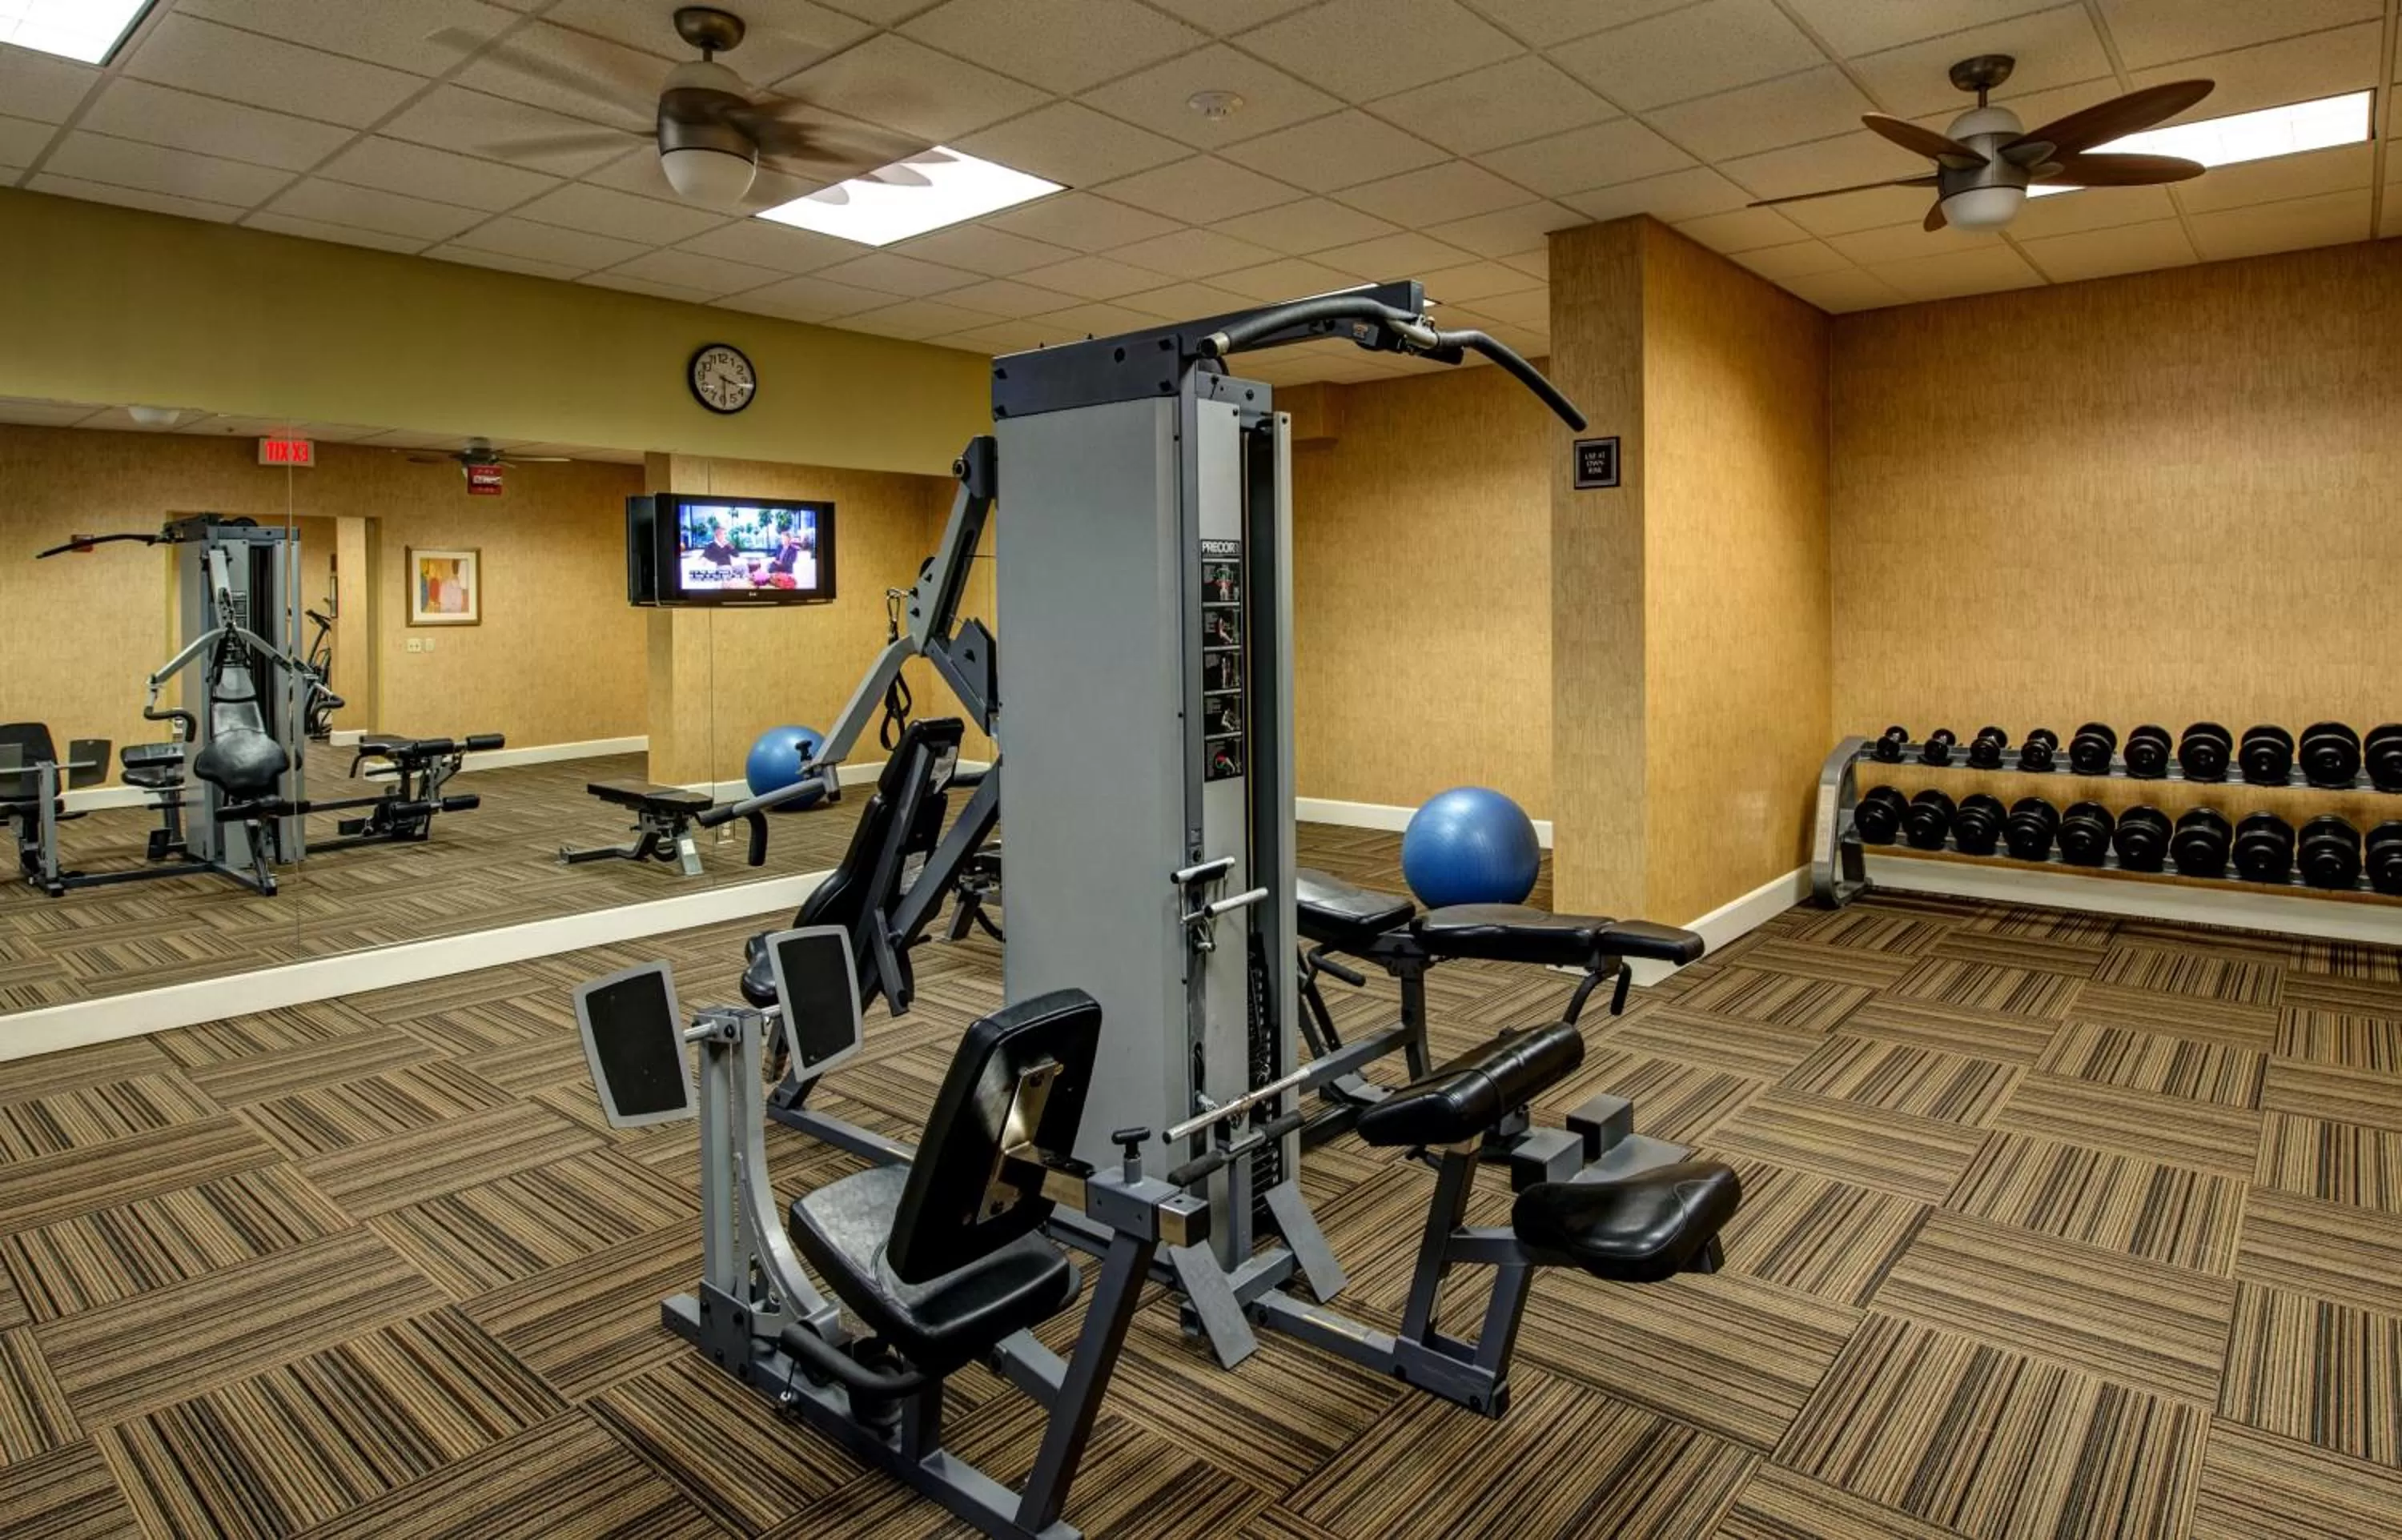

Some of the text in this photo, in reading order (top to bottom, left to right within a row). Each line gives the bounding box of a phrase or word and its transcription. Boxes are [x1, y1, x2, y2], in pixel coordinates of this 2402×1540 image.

[709, 355, 717, 366] 11
[717, 353, 728, 364] 12
[730, 358, 735, 367] 1
[736, 364, 744, 375] 2
[729, 393, 737, 403] 5
[737, 387, 744, 398] 4
[1202, 541, 1237, 553] PRECOR
